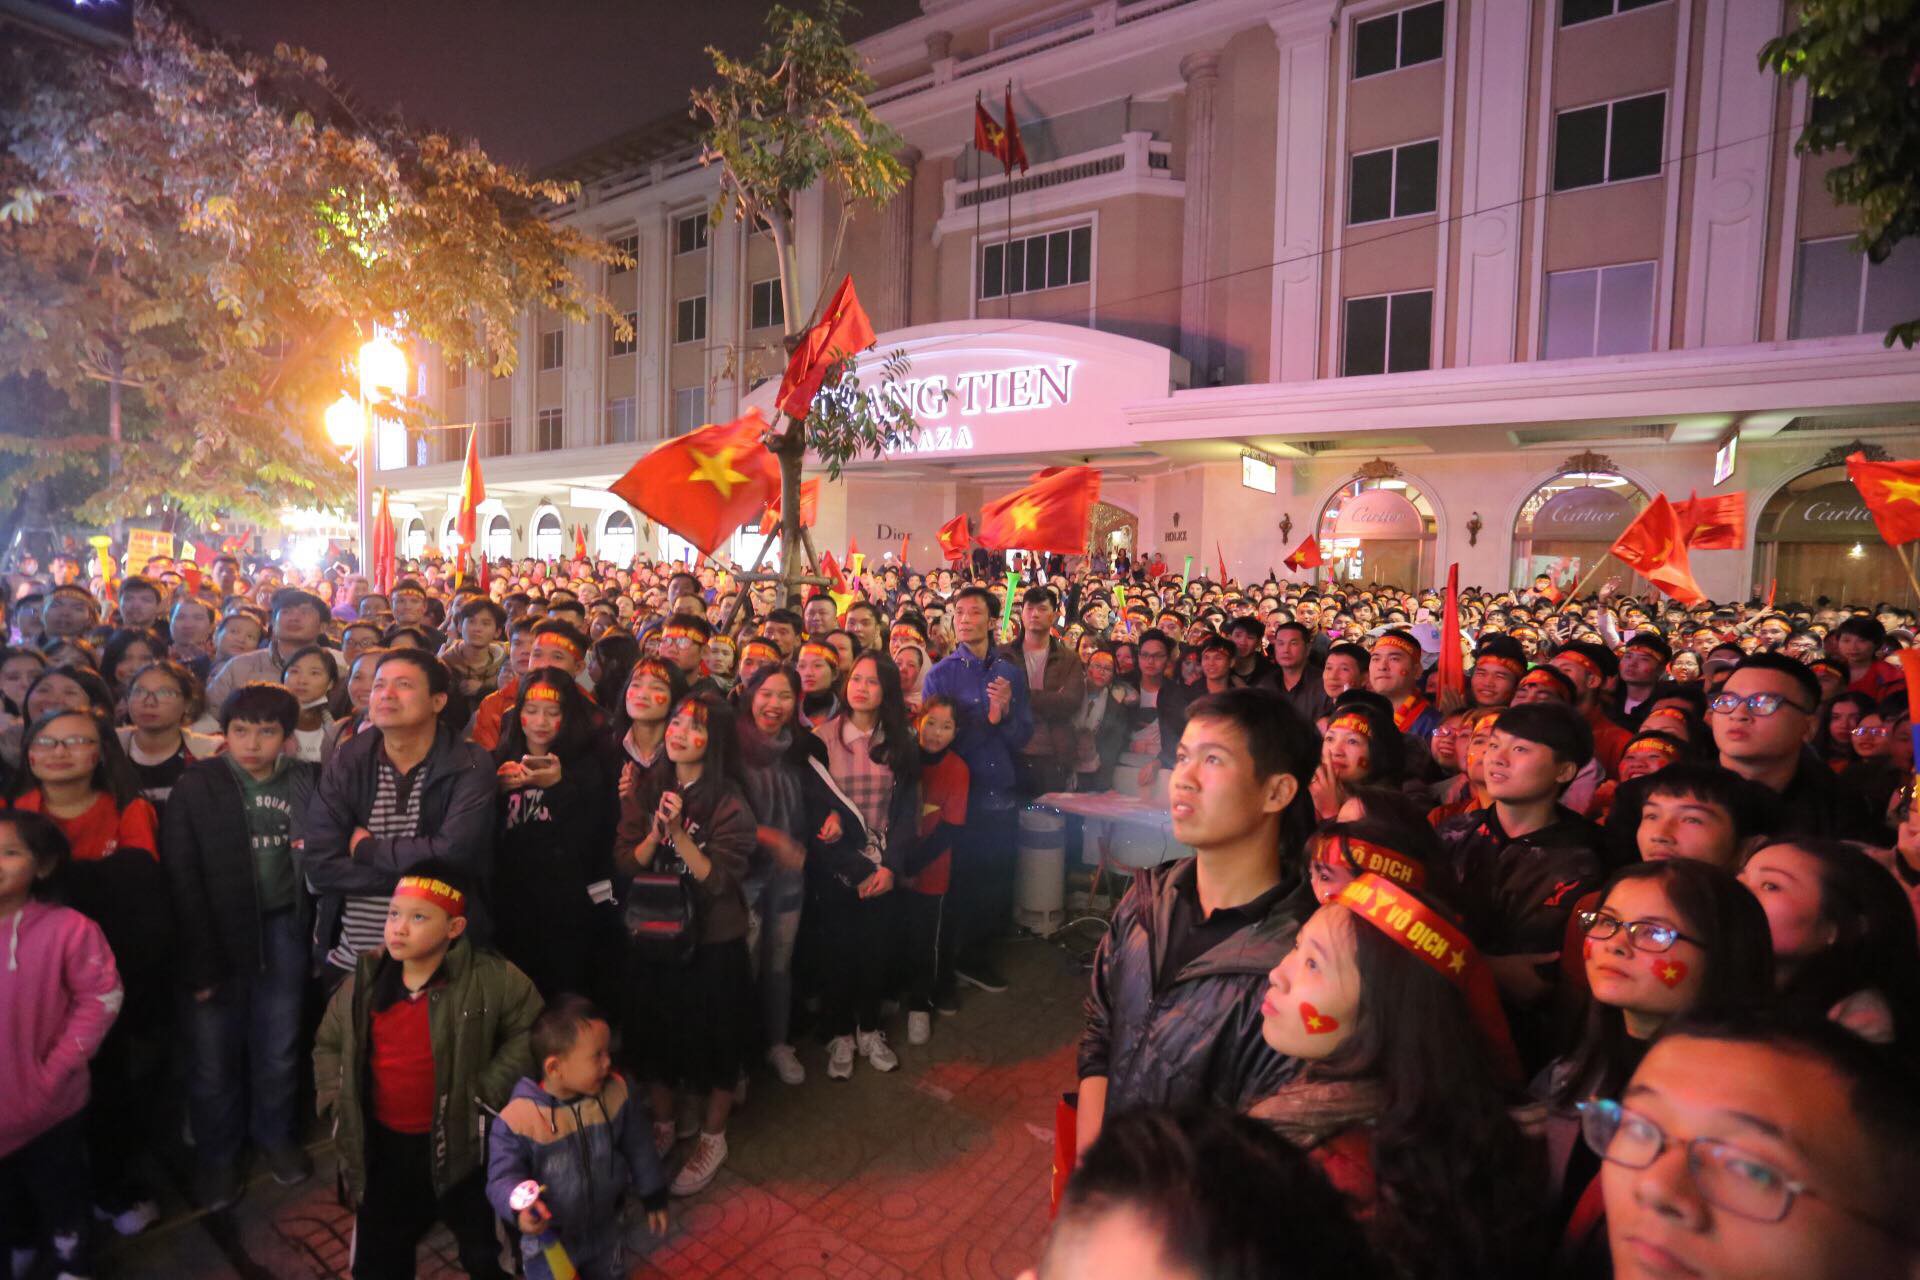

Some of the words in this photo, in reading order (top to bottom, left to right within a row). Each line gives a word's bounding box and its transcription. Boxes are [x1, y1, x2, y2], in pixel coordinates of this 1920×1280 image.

[811, 378, 947, 423] ANG
[956, 361, 1075, 414] TIEN
[1551, 504, 1620, 522] Cartier
[1803, 501, 1873, 521] Cartie
[1368, 853, 1413, 882] ĐỊCH
[1385, 905, 1414, 931] VÔ
[1406, 921, 1449, 959] ĐỊCH
